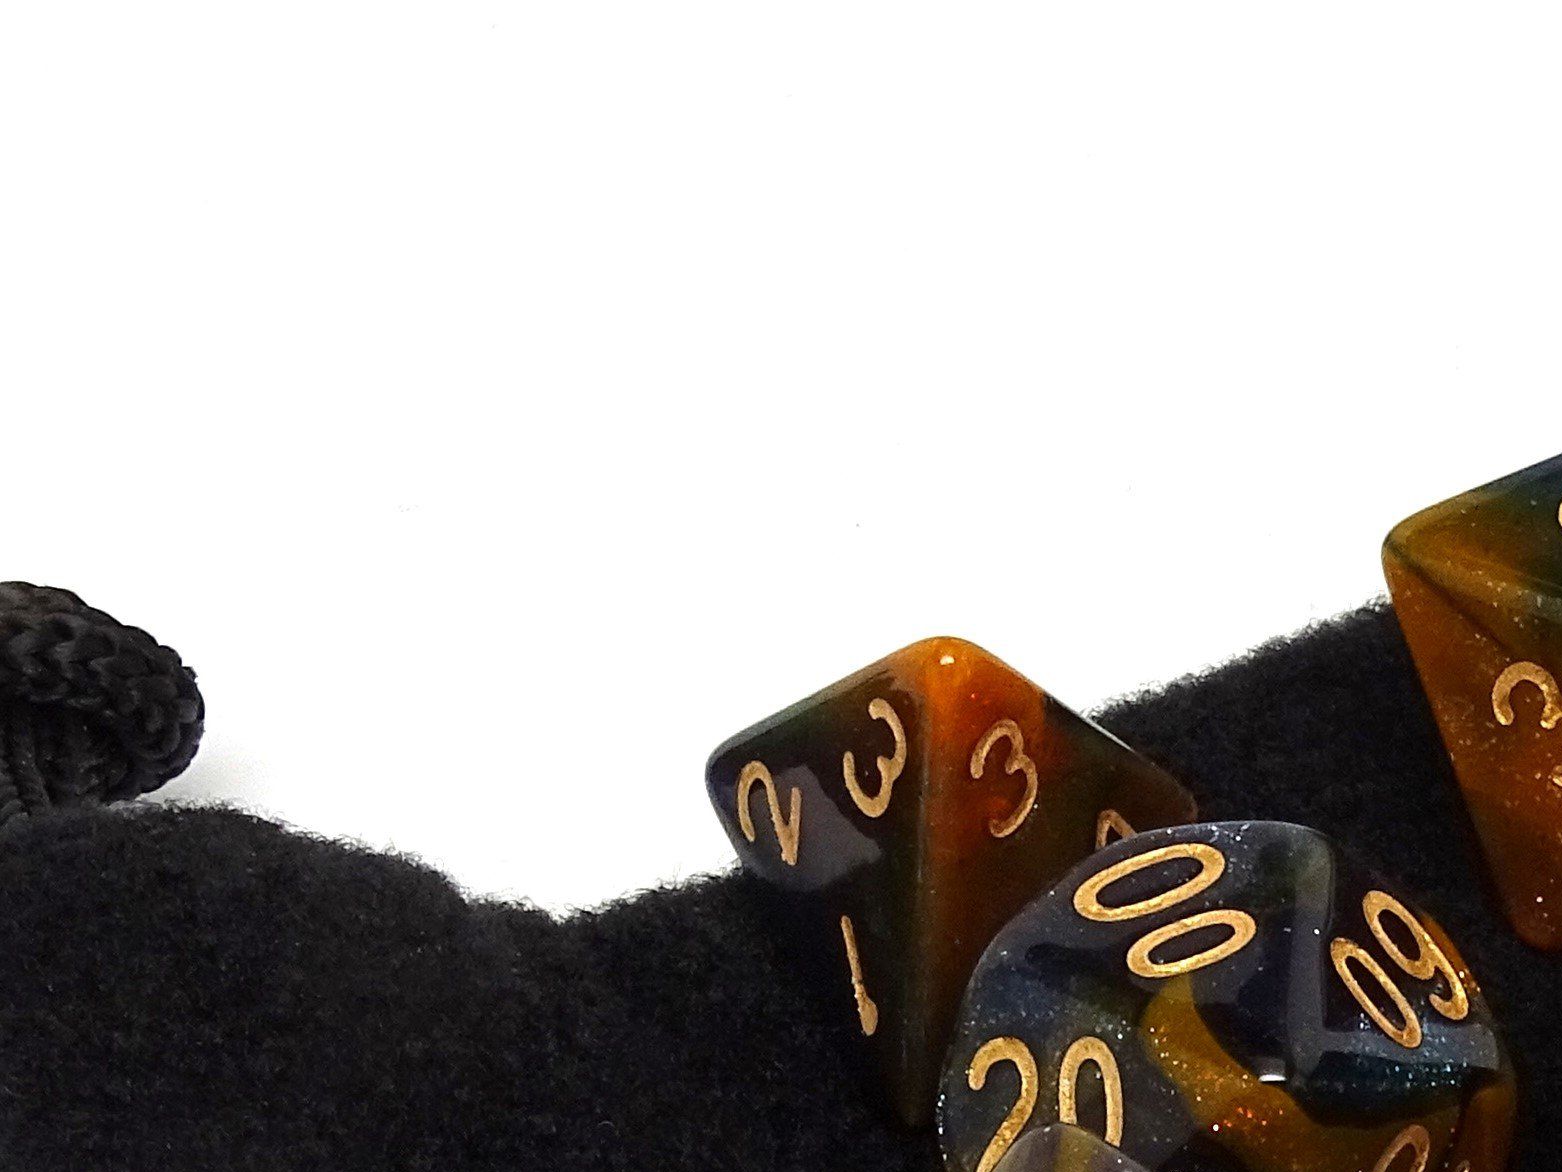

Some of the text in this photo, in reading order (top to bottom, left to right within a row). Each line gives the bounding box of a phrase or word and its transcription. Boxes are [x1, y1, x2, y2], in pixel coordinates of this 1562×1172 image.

[737, 760, 801, 866] 2
[843, 698, 906, 817] 3
[970, 719, 1038, 838] 3
[1073, 842, 1256, 977] 00
[841, 915, 878, 1036] 1
